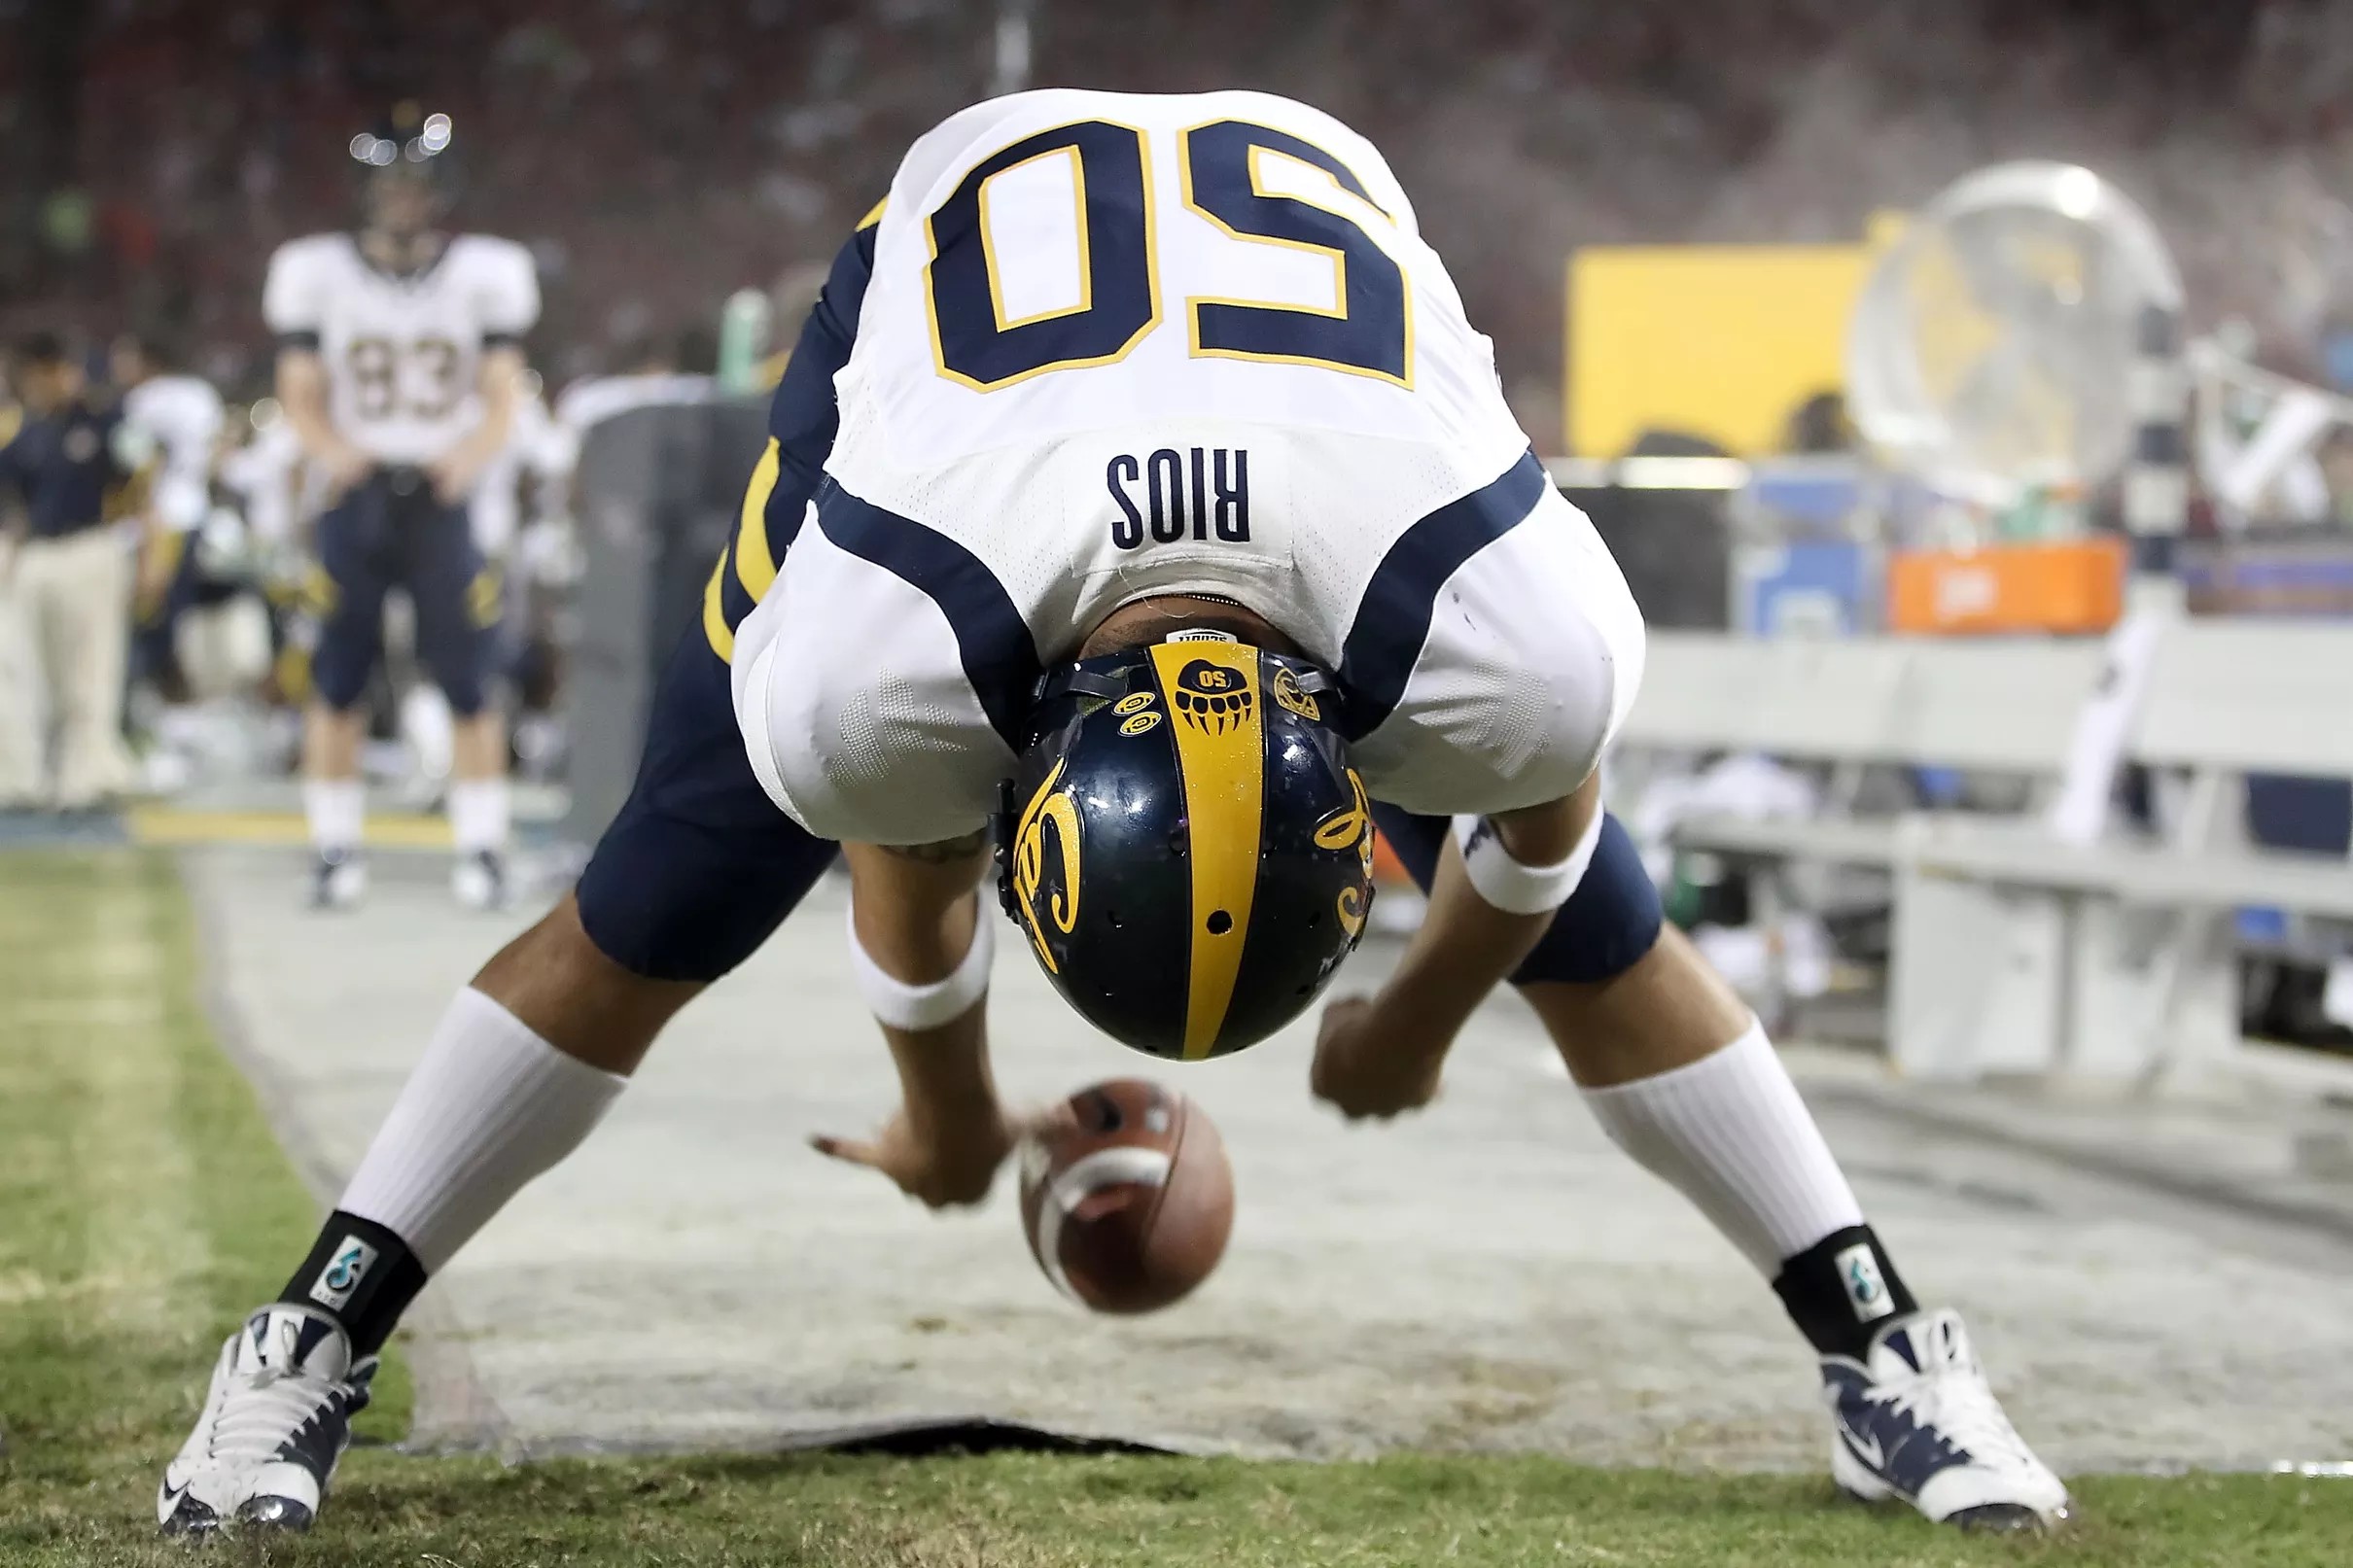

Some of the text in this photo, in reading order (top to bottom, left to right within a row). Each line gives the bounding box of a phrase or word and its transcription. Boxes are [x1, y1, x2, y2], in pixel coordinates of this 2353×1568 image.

[923, 117, 1415, 394] 50
[1106, 447, 1251, 550] RIOS
[1199, 671, 1227, 687] 50
